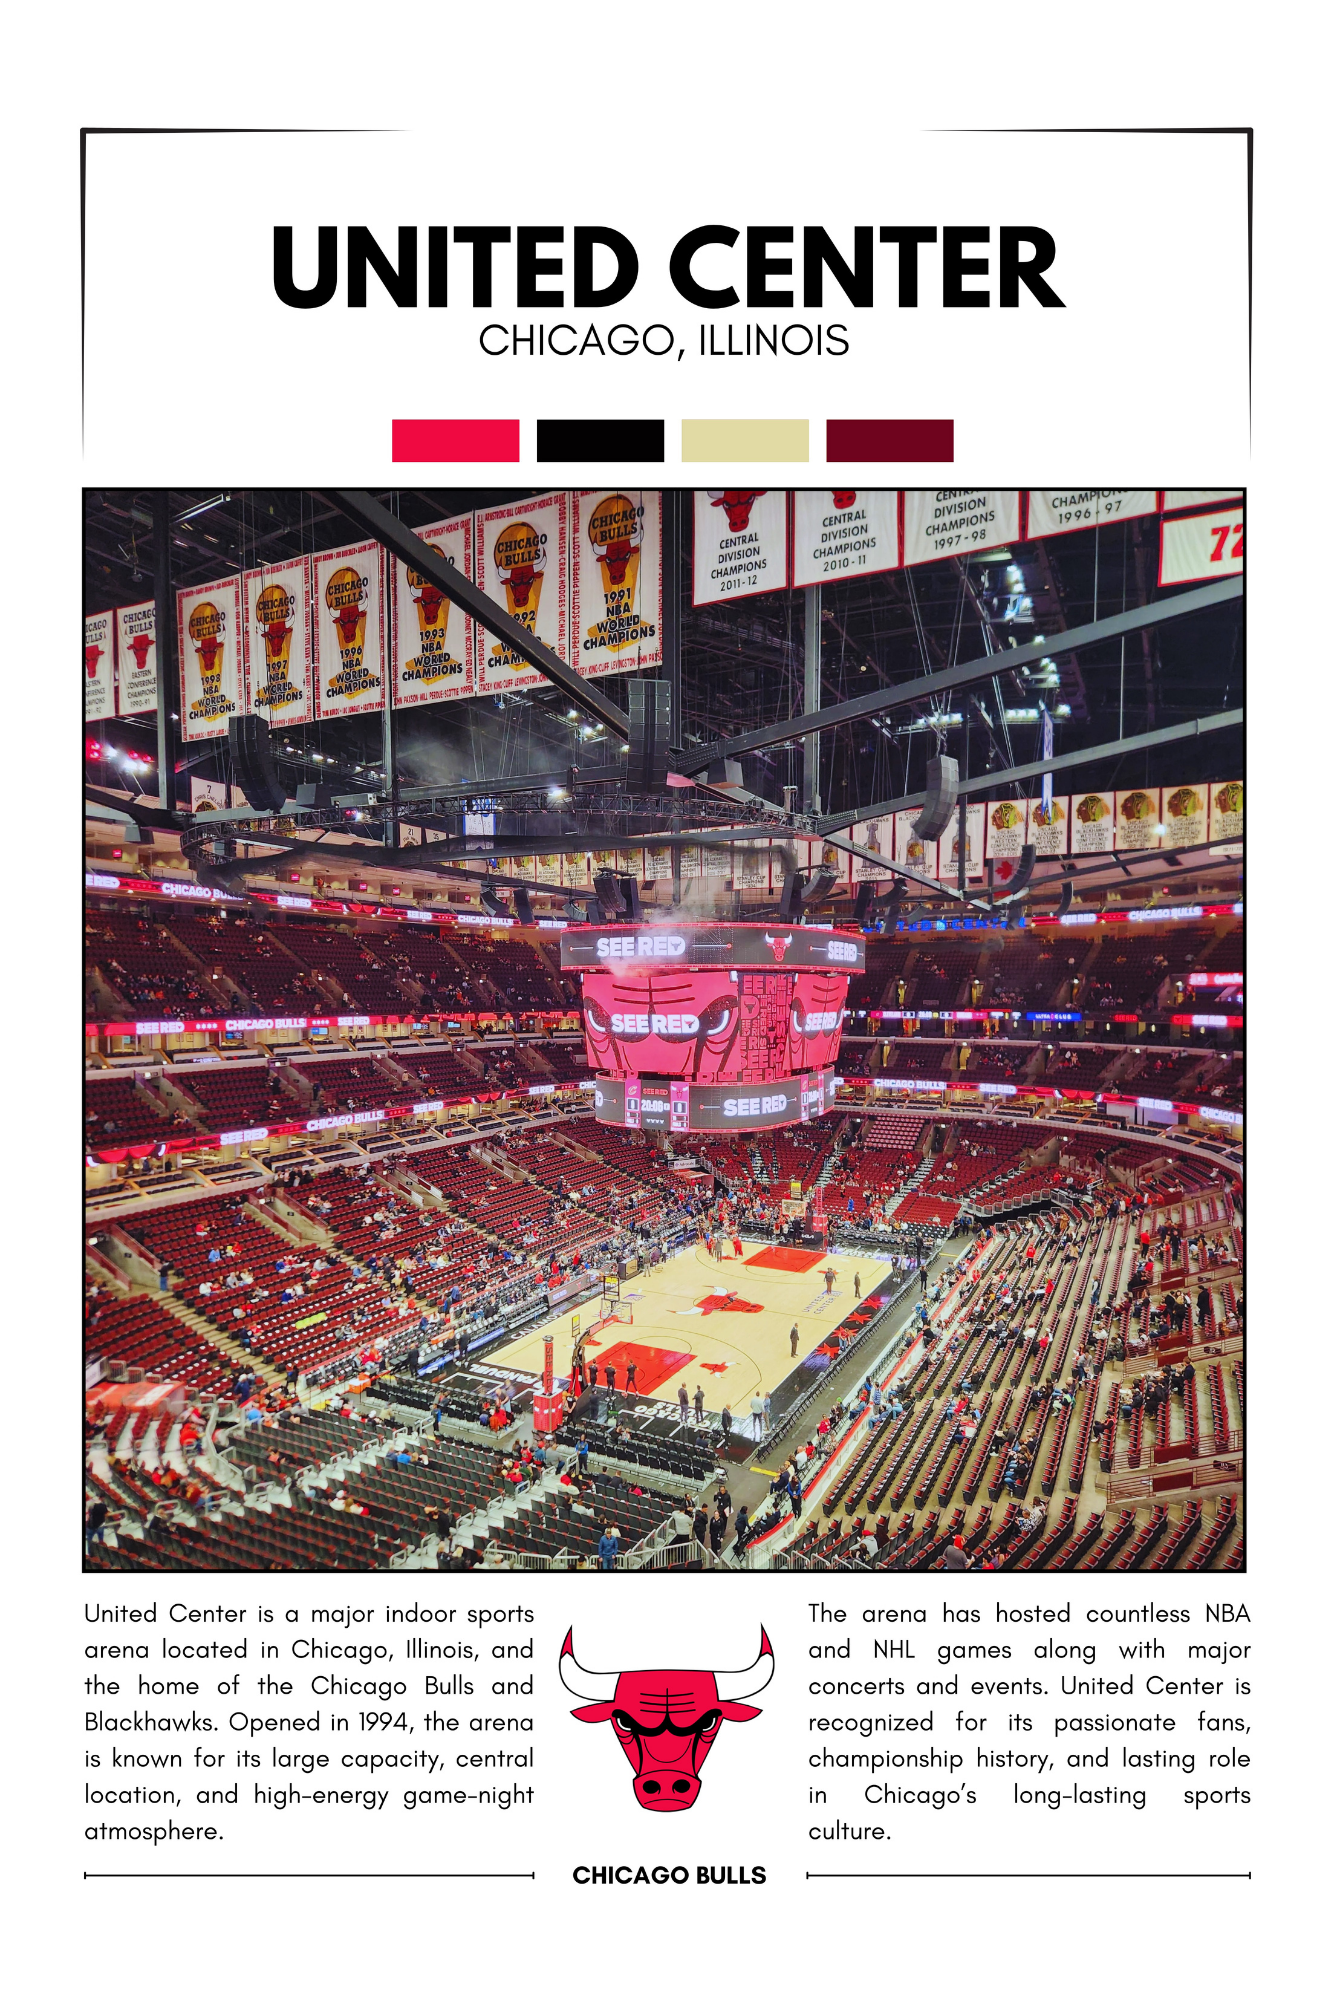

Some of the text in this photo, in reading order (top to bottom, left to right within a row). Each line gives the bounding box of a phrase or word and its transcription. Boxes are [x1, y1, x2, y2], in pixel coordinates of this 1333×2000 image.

[934, 497, 986, 519] DIVISION
[592, 506, 645, 529] CHICAGO
[822, 509, 867, 528] CENTRAL
[925, 511, 995, 536] CHAMPIONS
[599, 522, 638, 543] BULLS
[719, 532, 759, 550] CENTRAL
[821, 523, 868, 543] DIVISION
[497, 533, 548, 554] CHICAGO
[813, 537, 877, 559] CHAMPIONS
[504, 548, 541, 567] BULLS
[718, 546, 761, 564] DIVISION
[711, 558, 767, 579] CHAMPIONS
[328, 577, 369, 596] CHICAGO
[258, 595, 295, 612] CHICAGO
[334, 591, 364, 608] BULLS
[604, 588, 631, 605] 1991
[263, 607, 290, 622] BULLS
[606, 602, 631, 618] NBA
[128, 620, 153, 635] BULLS
[190, 611, 226, 628] CHICAGO
[596, 614, 640, 634] WORLD
[196, 624, 222, 639] BULLS
[419, 628, 445, 642] 1993
[583, 625, 656, 651] CHAMPIONS
[339, 645, 363, 660] 1996
[421, 640, 442, 654] NBA
[266, 659, 288, 673] 1997
[342, 657, 361, 671] NBA
[413, 651, 451, 667] WORLD
[131, 668, 152, 679] EASTERN
[200, 673, 221, 686] 1998
[269, 671, 286, 682] NBA
[335, 668, 369, 684] WORLD
[402, 662, 463, 683] CHAMPIONS
[127, 677, 157, 689] CONFERENCE
[203, 684, 219, 696] NBA
[262, 681, 293, 695] WORLD
[326, 677, 381, 698] CHAMPIONS
[127, 687, 157, 699] CHAMPIONS
[197, 694, 226, 707] WORLD
[254, 690, 303, 708] CHAMPIONS
[188, 702, 236, 720] CHAMPIONS
[162, 883, 212, 899] CHICAGO
[458, 914, 491, 924] CHICAGO
[1129, 908, 1169, 920] CHICAGO
[597, 936, 686, 957] SEE RED
[828, 940, 857, 962] SEE RED
[136, 1021, 185, 1034] SEE RED
[226, 1019, 274, 1031] CHICAGO
[611, 1014, 700, 1034] SEE RED
[805, 1011, 838, 1031] SEE RED
[874, 1079, 915, 1089] CHICAGO
[724, 1097, 761, 1117] SEE
[761, 1094, 788, 1114] RED
[220, 1128, 268, 1145] SEE RED
